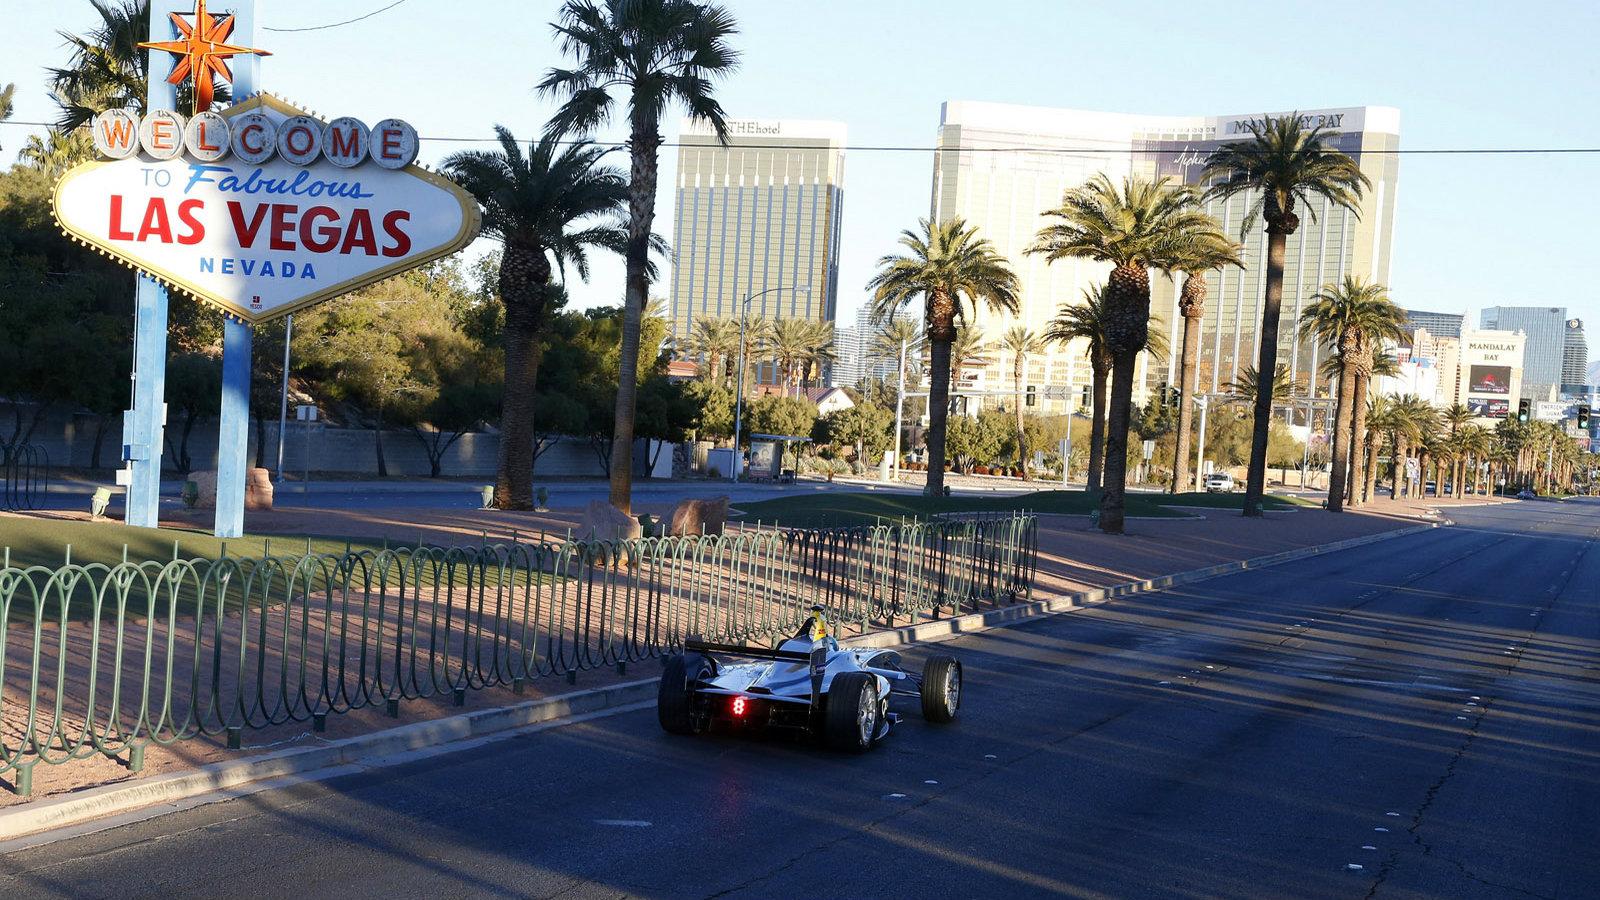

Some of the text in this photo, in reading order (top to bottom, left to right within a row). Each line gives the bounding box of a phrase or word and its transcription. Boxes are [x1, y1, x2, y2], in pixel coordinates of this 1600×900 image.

[1318, 113, 1344, 129] BAY
[102, 119, 403, 160] WELCOME
[140, 164, 374, 199] TO Fabulous
[109, 194, 411, 257] LAS VEGAS
[200, 257, 316, 279] NEVADA
[1469, 343, 1516, 351] MANDALAY
[1484, 353, 1499, 361] BAY
